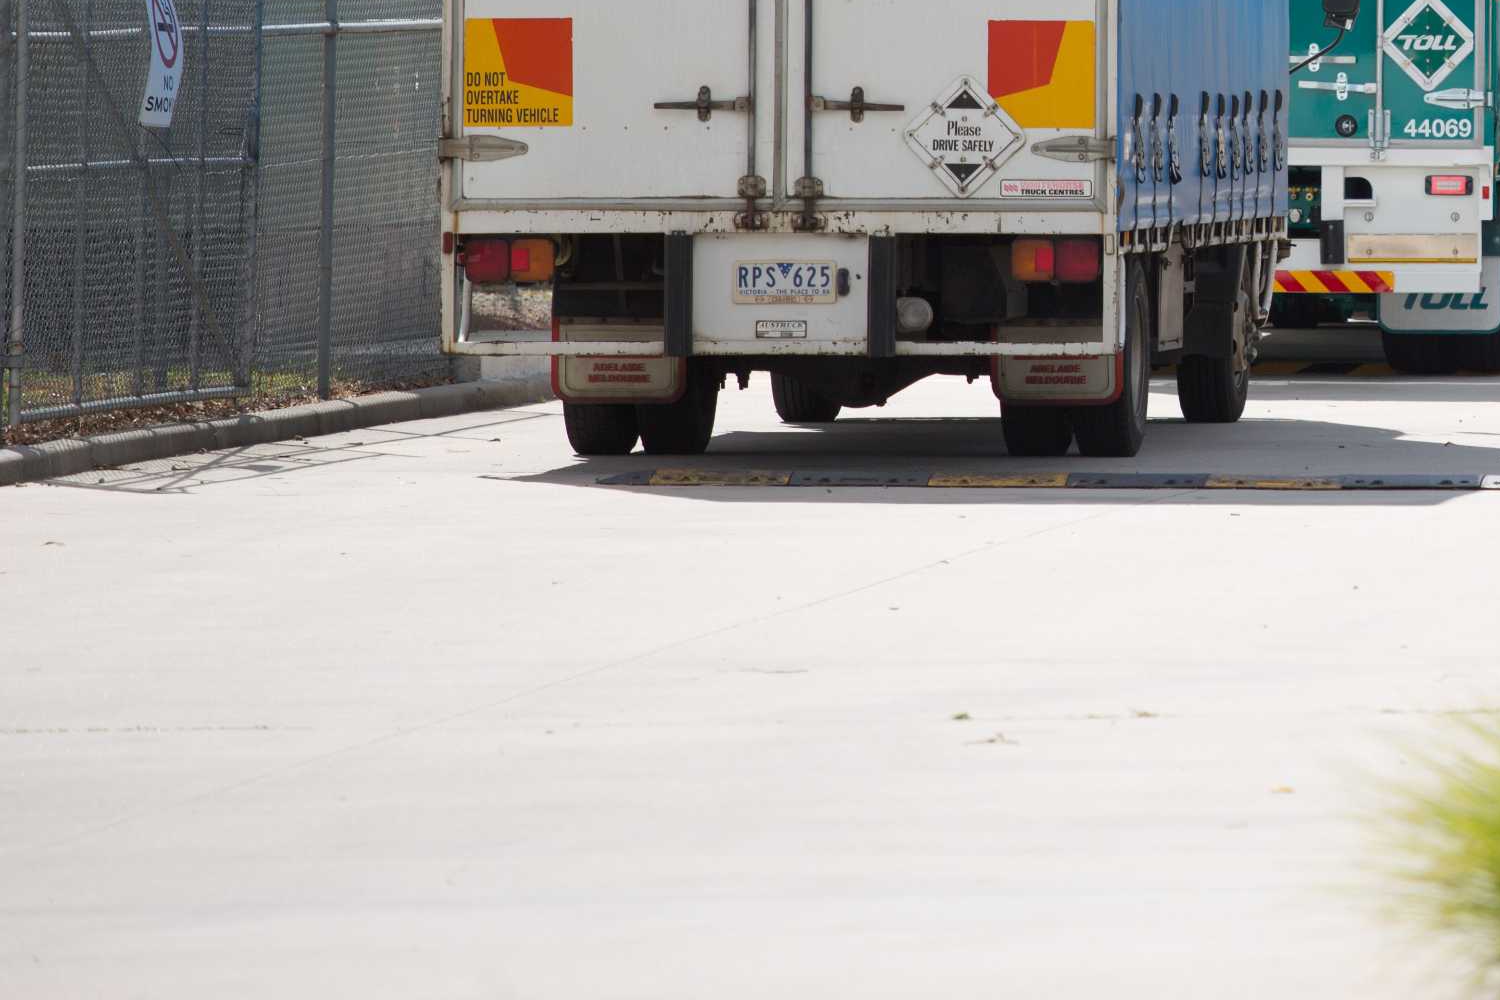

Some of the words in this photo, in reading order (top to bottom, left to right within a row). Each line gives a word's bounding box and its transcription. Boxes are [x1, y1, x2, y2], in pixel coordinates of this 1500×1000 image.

[1398, 34, 1457, 51] TOLL
[163, 74, 174, 91] NO
[466, 71, 481, 87] DO
[484, 71, 505, 87] NOT
[466, 90, 519, 105] OVERTAKE
[466, 108, 513, 123] TURNING
[516, 108, 559, 122] VEHICLE
[947, 121, 982, 137] Please
[1404, 119, 1472, 137] 44069
[932, 139, 959, 152] DRIVE
[961, 139, 994, 152] SAFELY
[738, 266, 776, 288] RPS
[793, 266, 830, 288] 625
